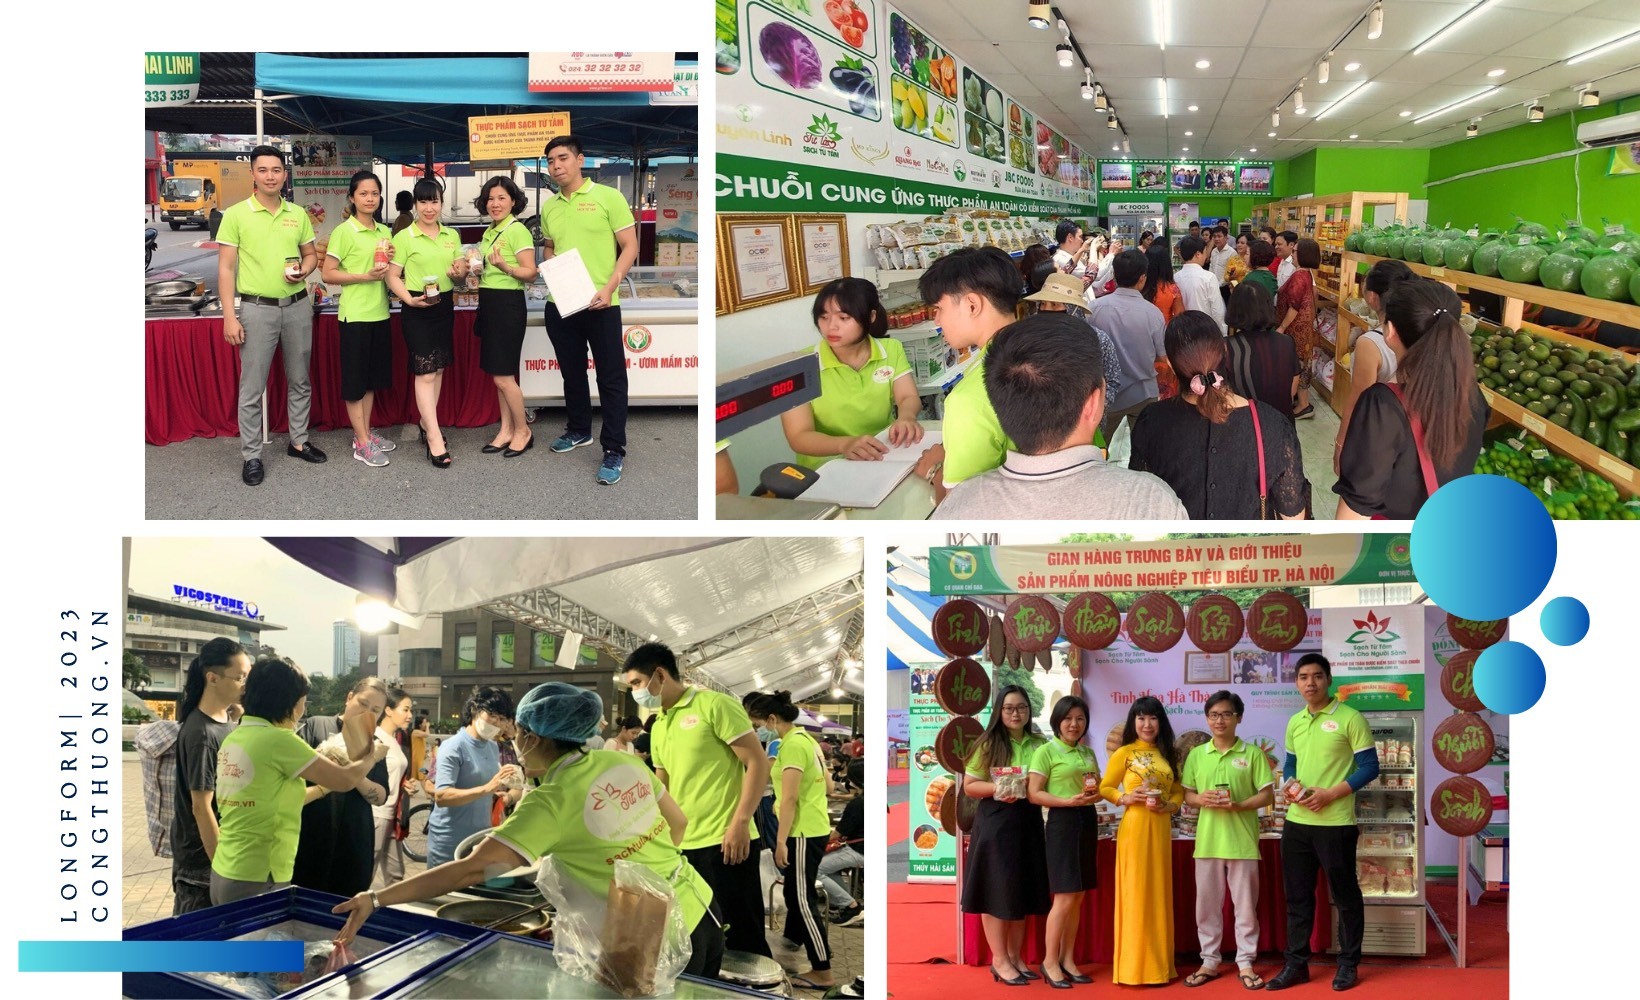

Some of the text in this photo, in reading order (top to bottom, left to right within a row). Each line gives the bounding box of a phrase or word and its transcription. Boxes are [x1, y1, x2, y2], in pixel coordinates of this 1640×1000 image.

[165, 55, 193, 74] LINH
[584, 64, 597, 72] 32
[599, 64, 612, 72] 32
[614, 64, 627, 72] 32
[628, 64, 641, 72] 32
[170, 89, 190, 101] 333
[475, 118, 564, 133] THỰC PHẨM SẠCH TỪ TÂM
[762, 129, 793, 146] Linh
[313, 168, 331, 176] PHẨM
[1004, 171, 1034, 187] JBC FOODS
[715, 171, 813, 200] CHUỖI
[820, 183, 887, 203] CUNG
[891, 187, 925, 206] ỨNG
[961, 193, 988, 210] PHẨM
[989, 200, 1000, 209] AN
[1001, 200, 1018, 212] TOÀN
[1018, 202, 1027, 212] CÓ
[524, 359, 546, 373] THỰC
[548, 359, 560, 370] PH
[639, 356, 658, 369] ƯƠM
[1047, 541, 1301, 566] GIAN HÀNG TRƯNG BÀY VÀ GIỚI THIỆU
[1017, 563, 1335, 589] SẢN PHẨM NÔNG NGHIỆP TIÊU BIỂU TP. HÀ NỘI
[173, 584, 244, 610] VICOSTONE
[1134, 605, 1179, 642] Sạch
[950, 665, 982, 706] Hoa
[912, 861, 928, 872] THỦY
[929, 862, 941, 871] HẢI
